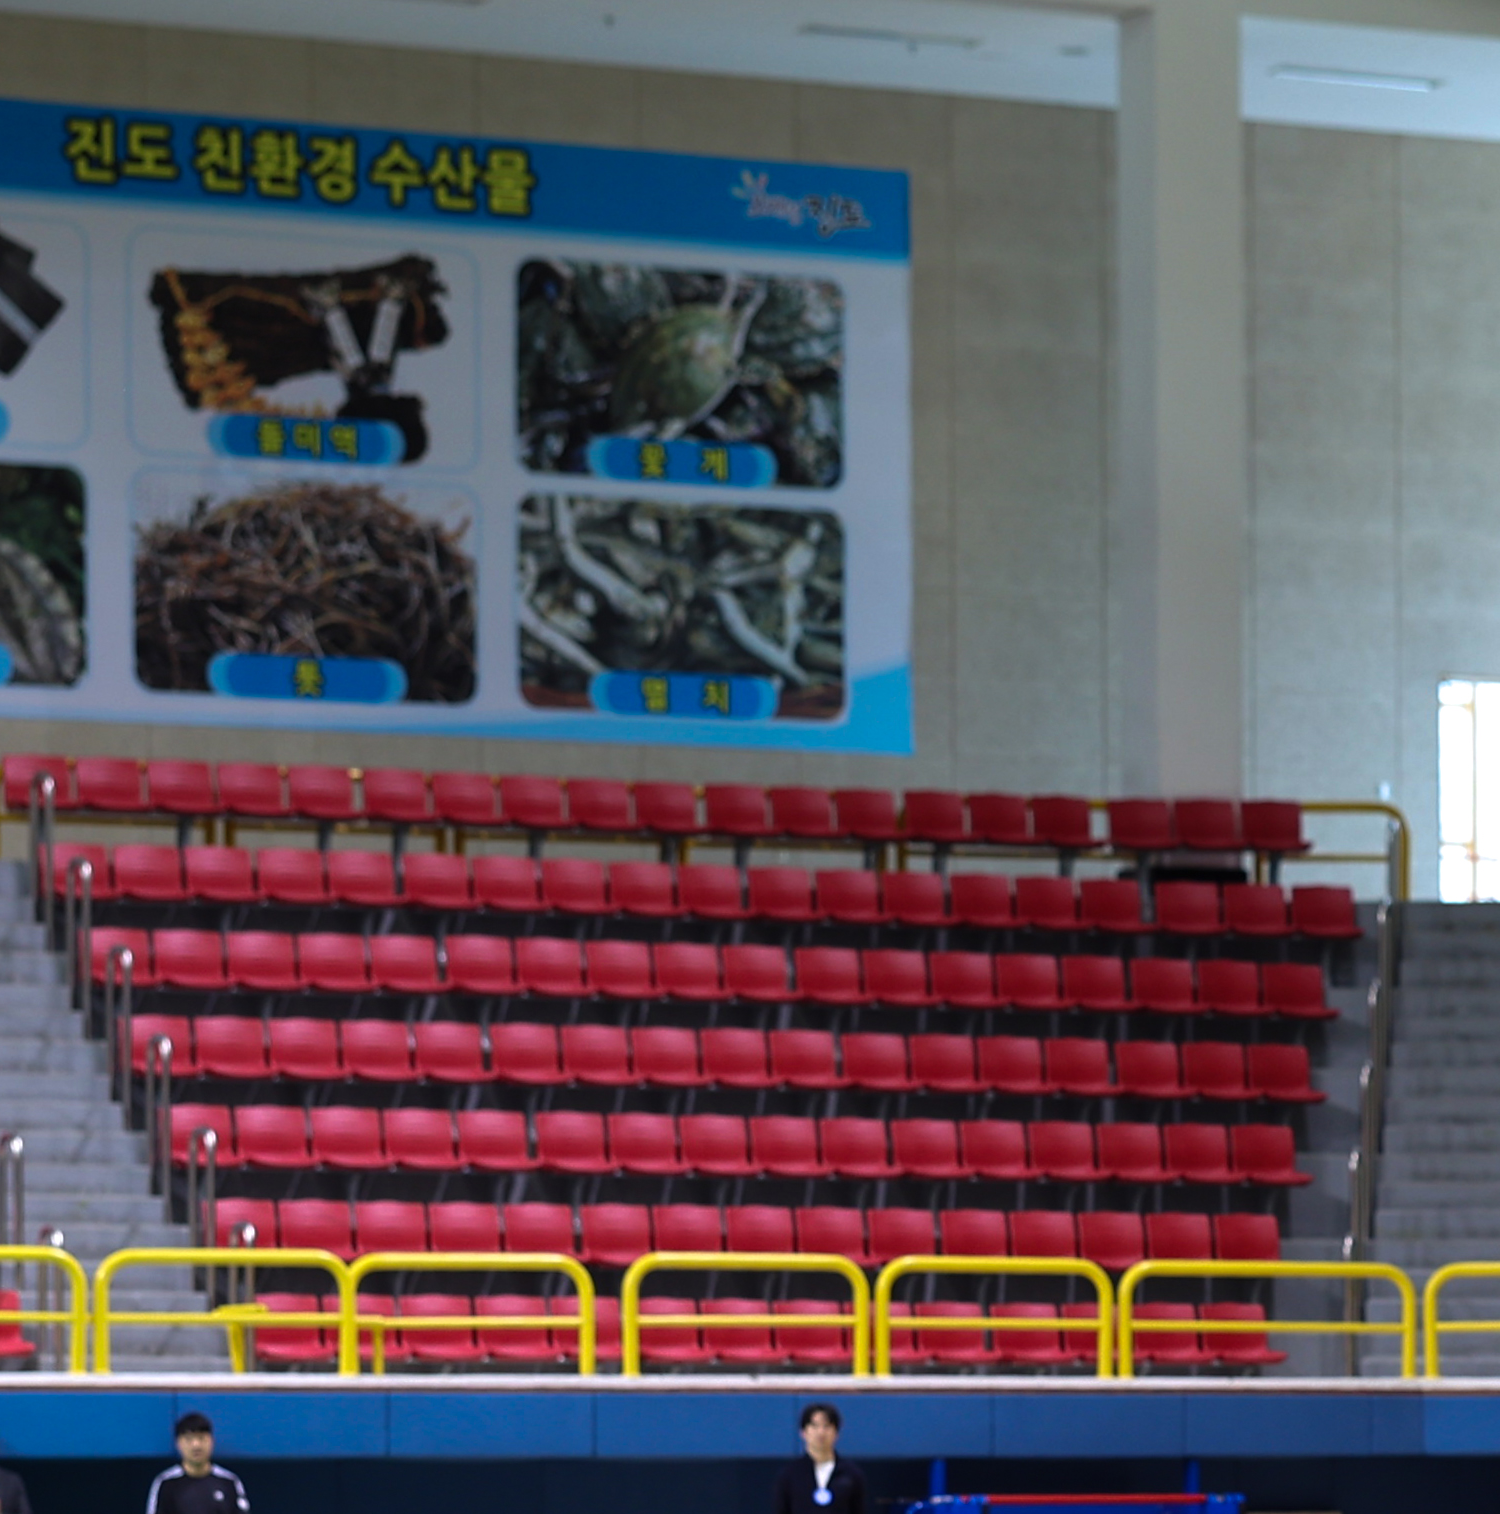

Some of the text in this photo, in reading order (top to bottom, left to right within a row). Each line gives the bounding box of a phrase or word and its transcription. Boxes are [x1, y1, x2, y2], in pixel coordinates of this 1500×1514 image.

[63, 115, 537, 216] 진도 친환경 수산물
